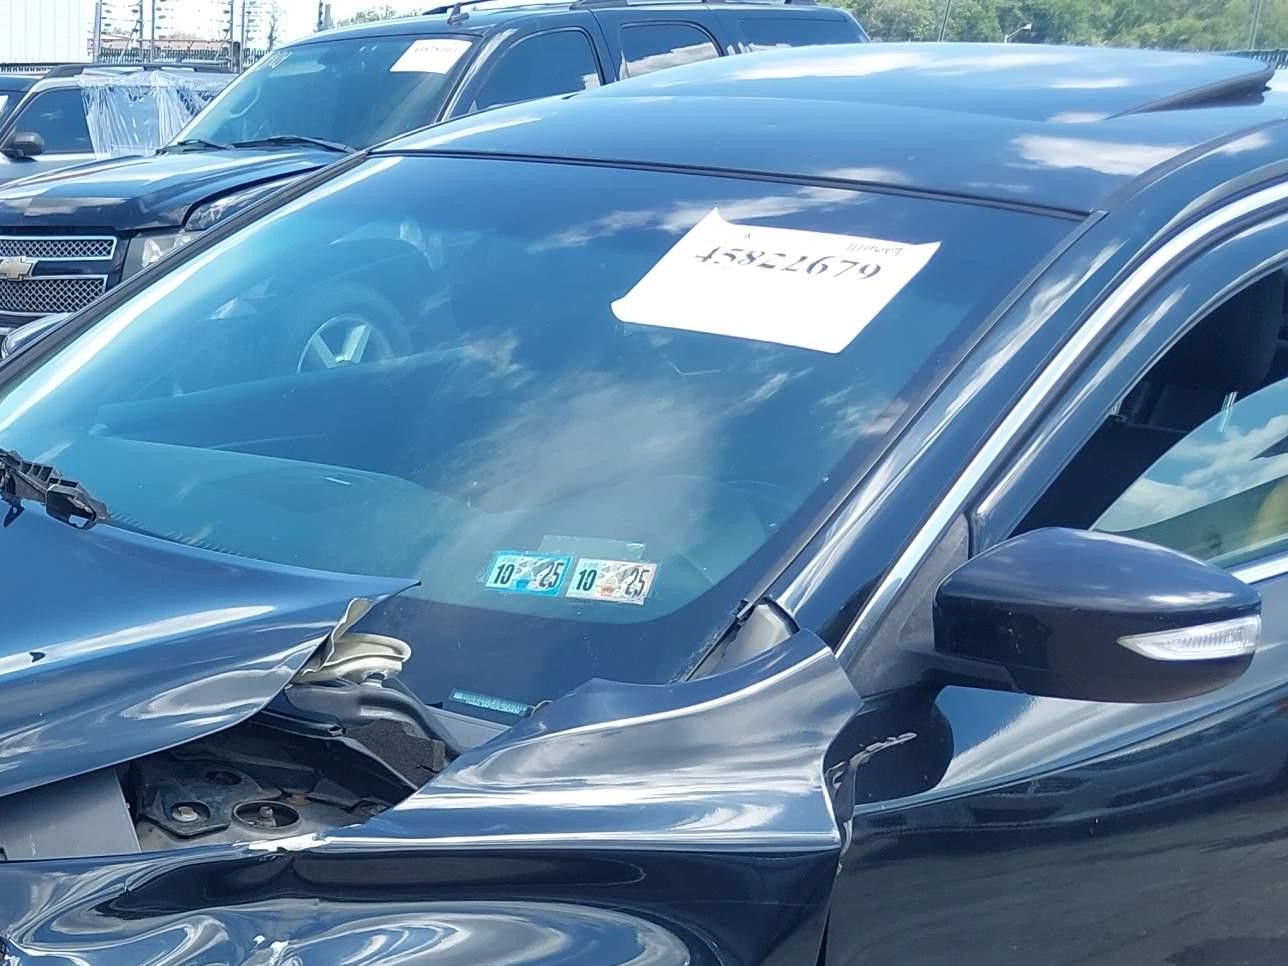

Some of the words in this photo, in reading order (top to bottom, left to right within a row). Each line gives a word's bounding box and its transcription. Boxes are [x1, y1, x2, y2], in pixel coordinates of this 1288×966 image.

[693, 245, 883, 281] 45822679
[493, 563, 516, 585] 10
[538, 560, 564, 588] 25
[576, 568, 598, 592] 10
[624, 567, 650, 598] 25
